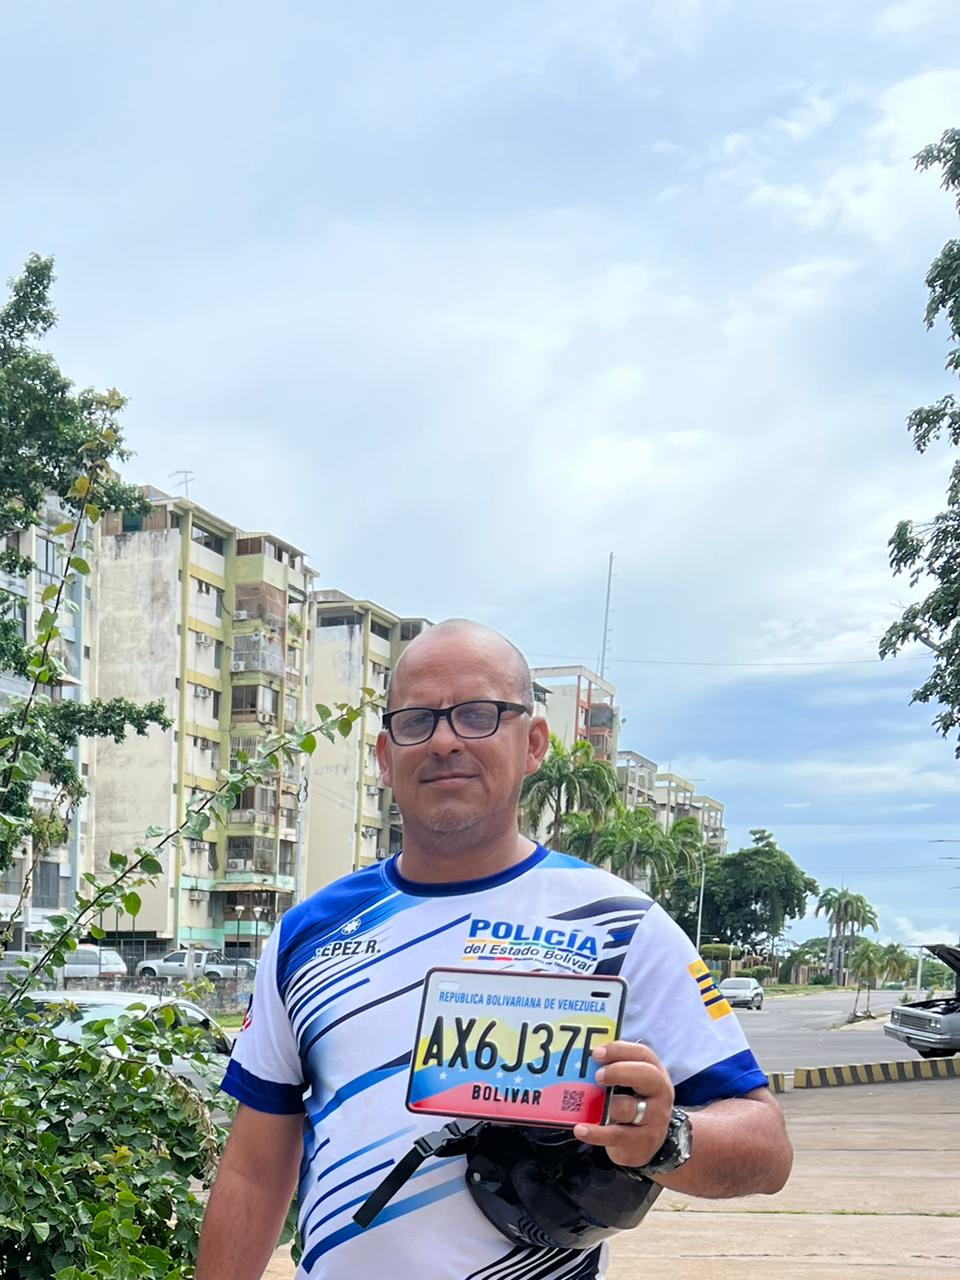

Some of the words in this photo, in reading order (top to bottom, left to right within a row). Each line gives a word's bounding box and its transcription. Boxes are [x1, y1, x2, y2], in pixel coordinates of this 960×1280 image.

[365, 939, 382, 954] R.
[468, 919, 598, 956] POLICÍA
[463, 943, 487, 955] del
[489, 944, 540, 956] Estado
[543, 949, 594, 973] Bolívar
[438, 991, 484, 1005] REPUBLICA
[486, 994, 541, 1009] BOLIVARIANA
[543, 998, 556, 1009] DE
[557, 999, 606, 1013] VENEZUELA
[422, 1015, 609, 1078] AX6J37F
[472, 1084, 542, 1106] BOLIVAR
